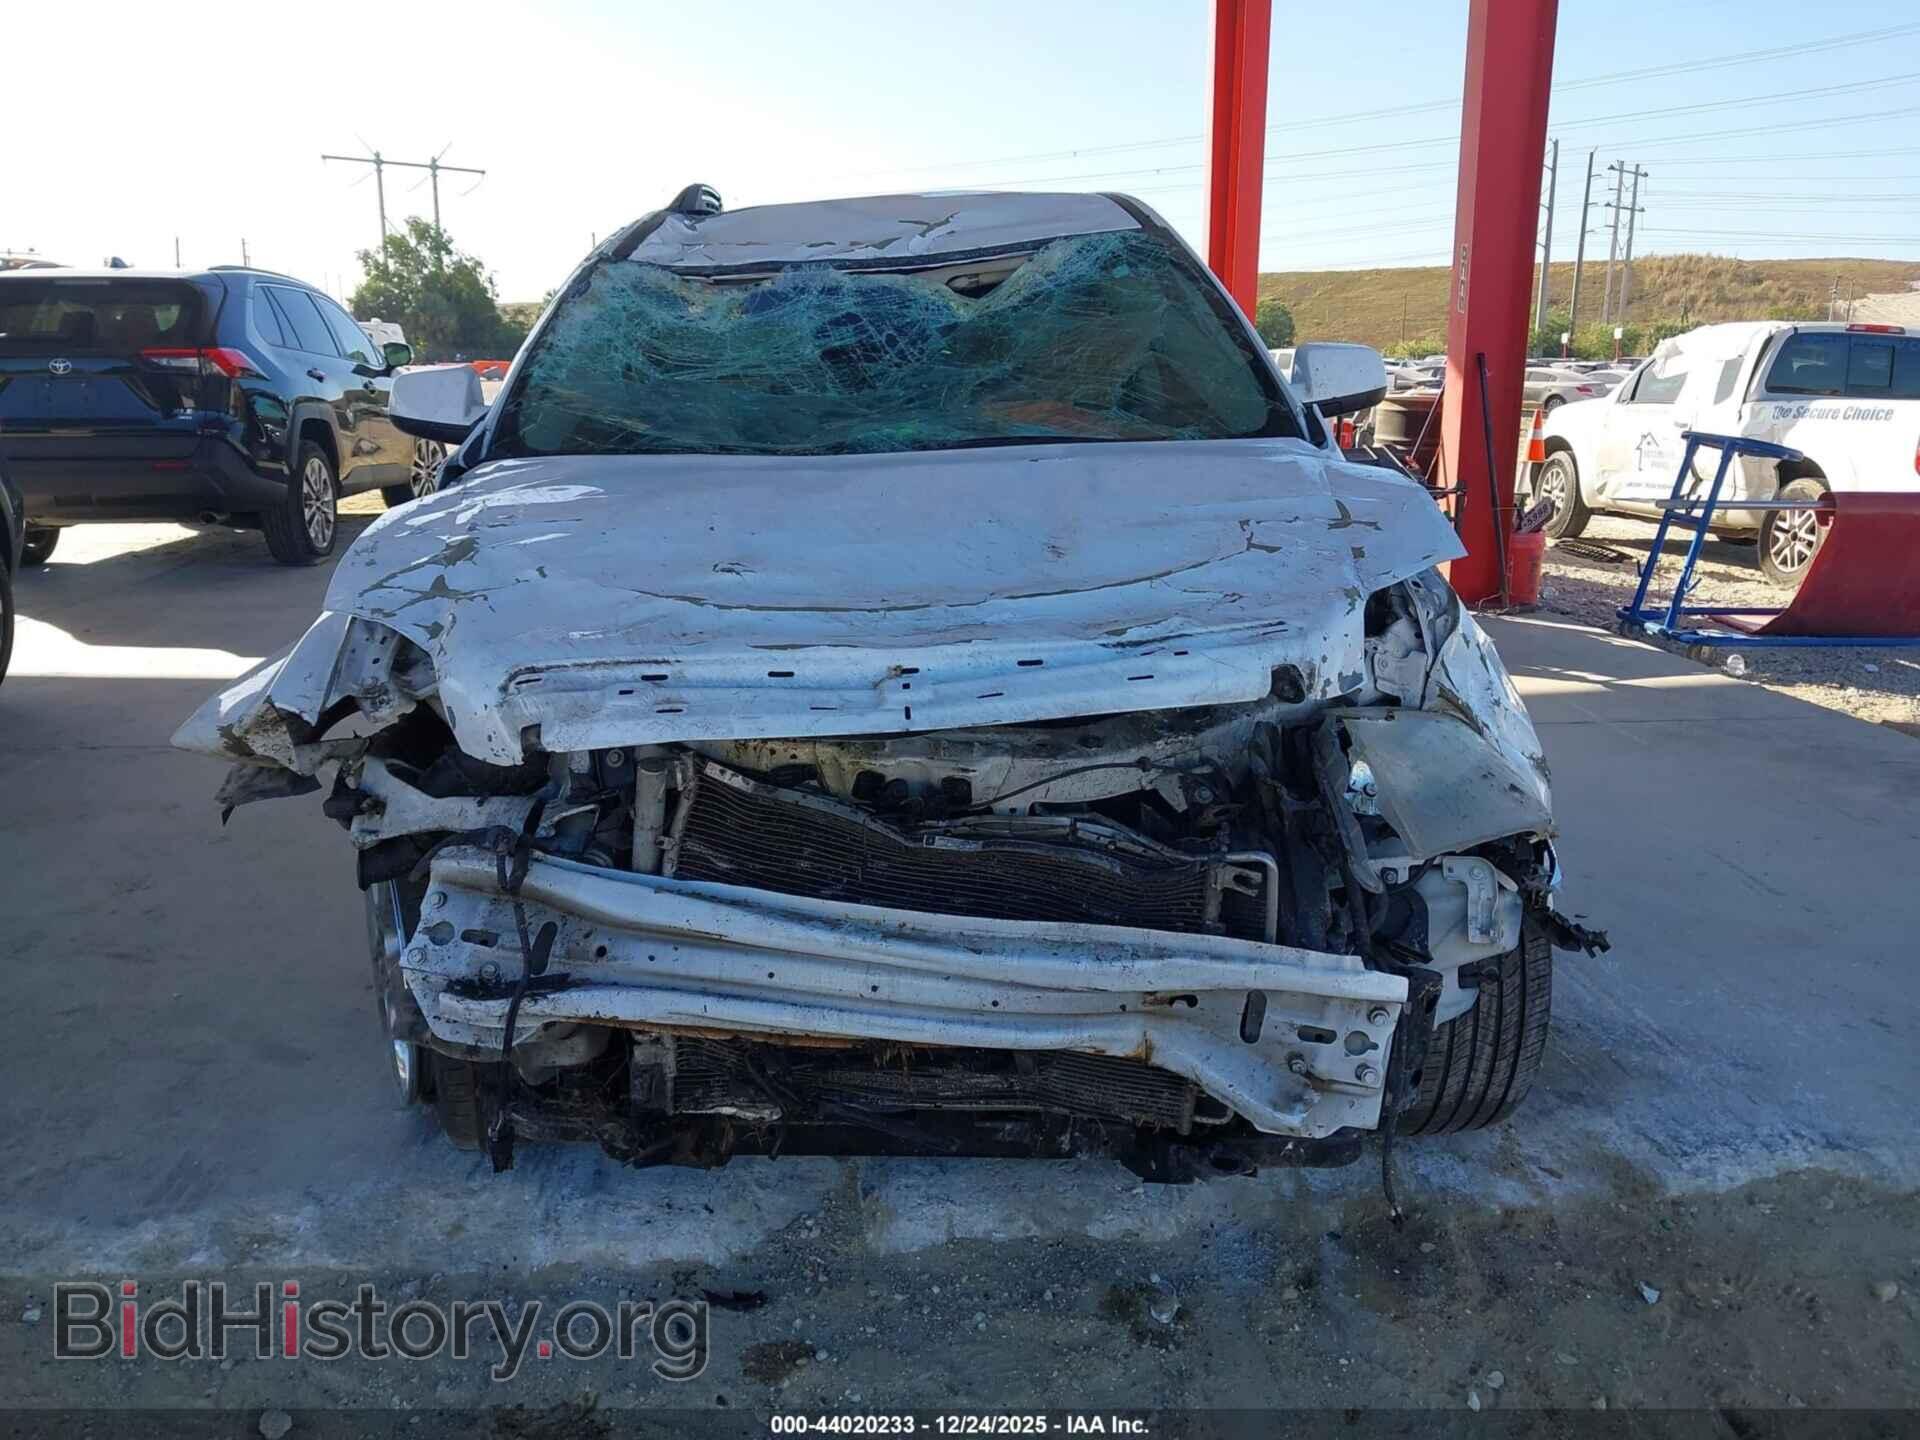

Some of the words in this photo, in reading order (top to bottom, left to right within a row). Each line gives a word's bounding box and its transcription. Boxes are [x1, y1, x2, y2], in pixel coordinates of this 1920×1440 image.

[1771, 405, 1793, 420] The
[1793, 405, 1841, 420] Secure
[1842, 406, 1895, 421] Choice
